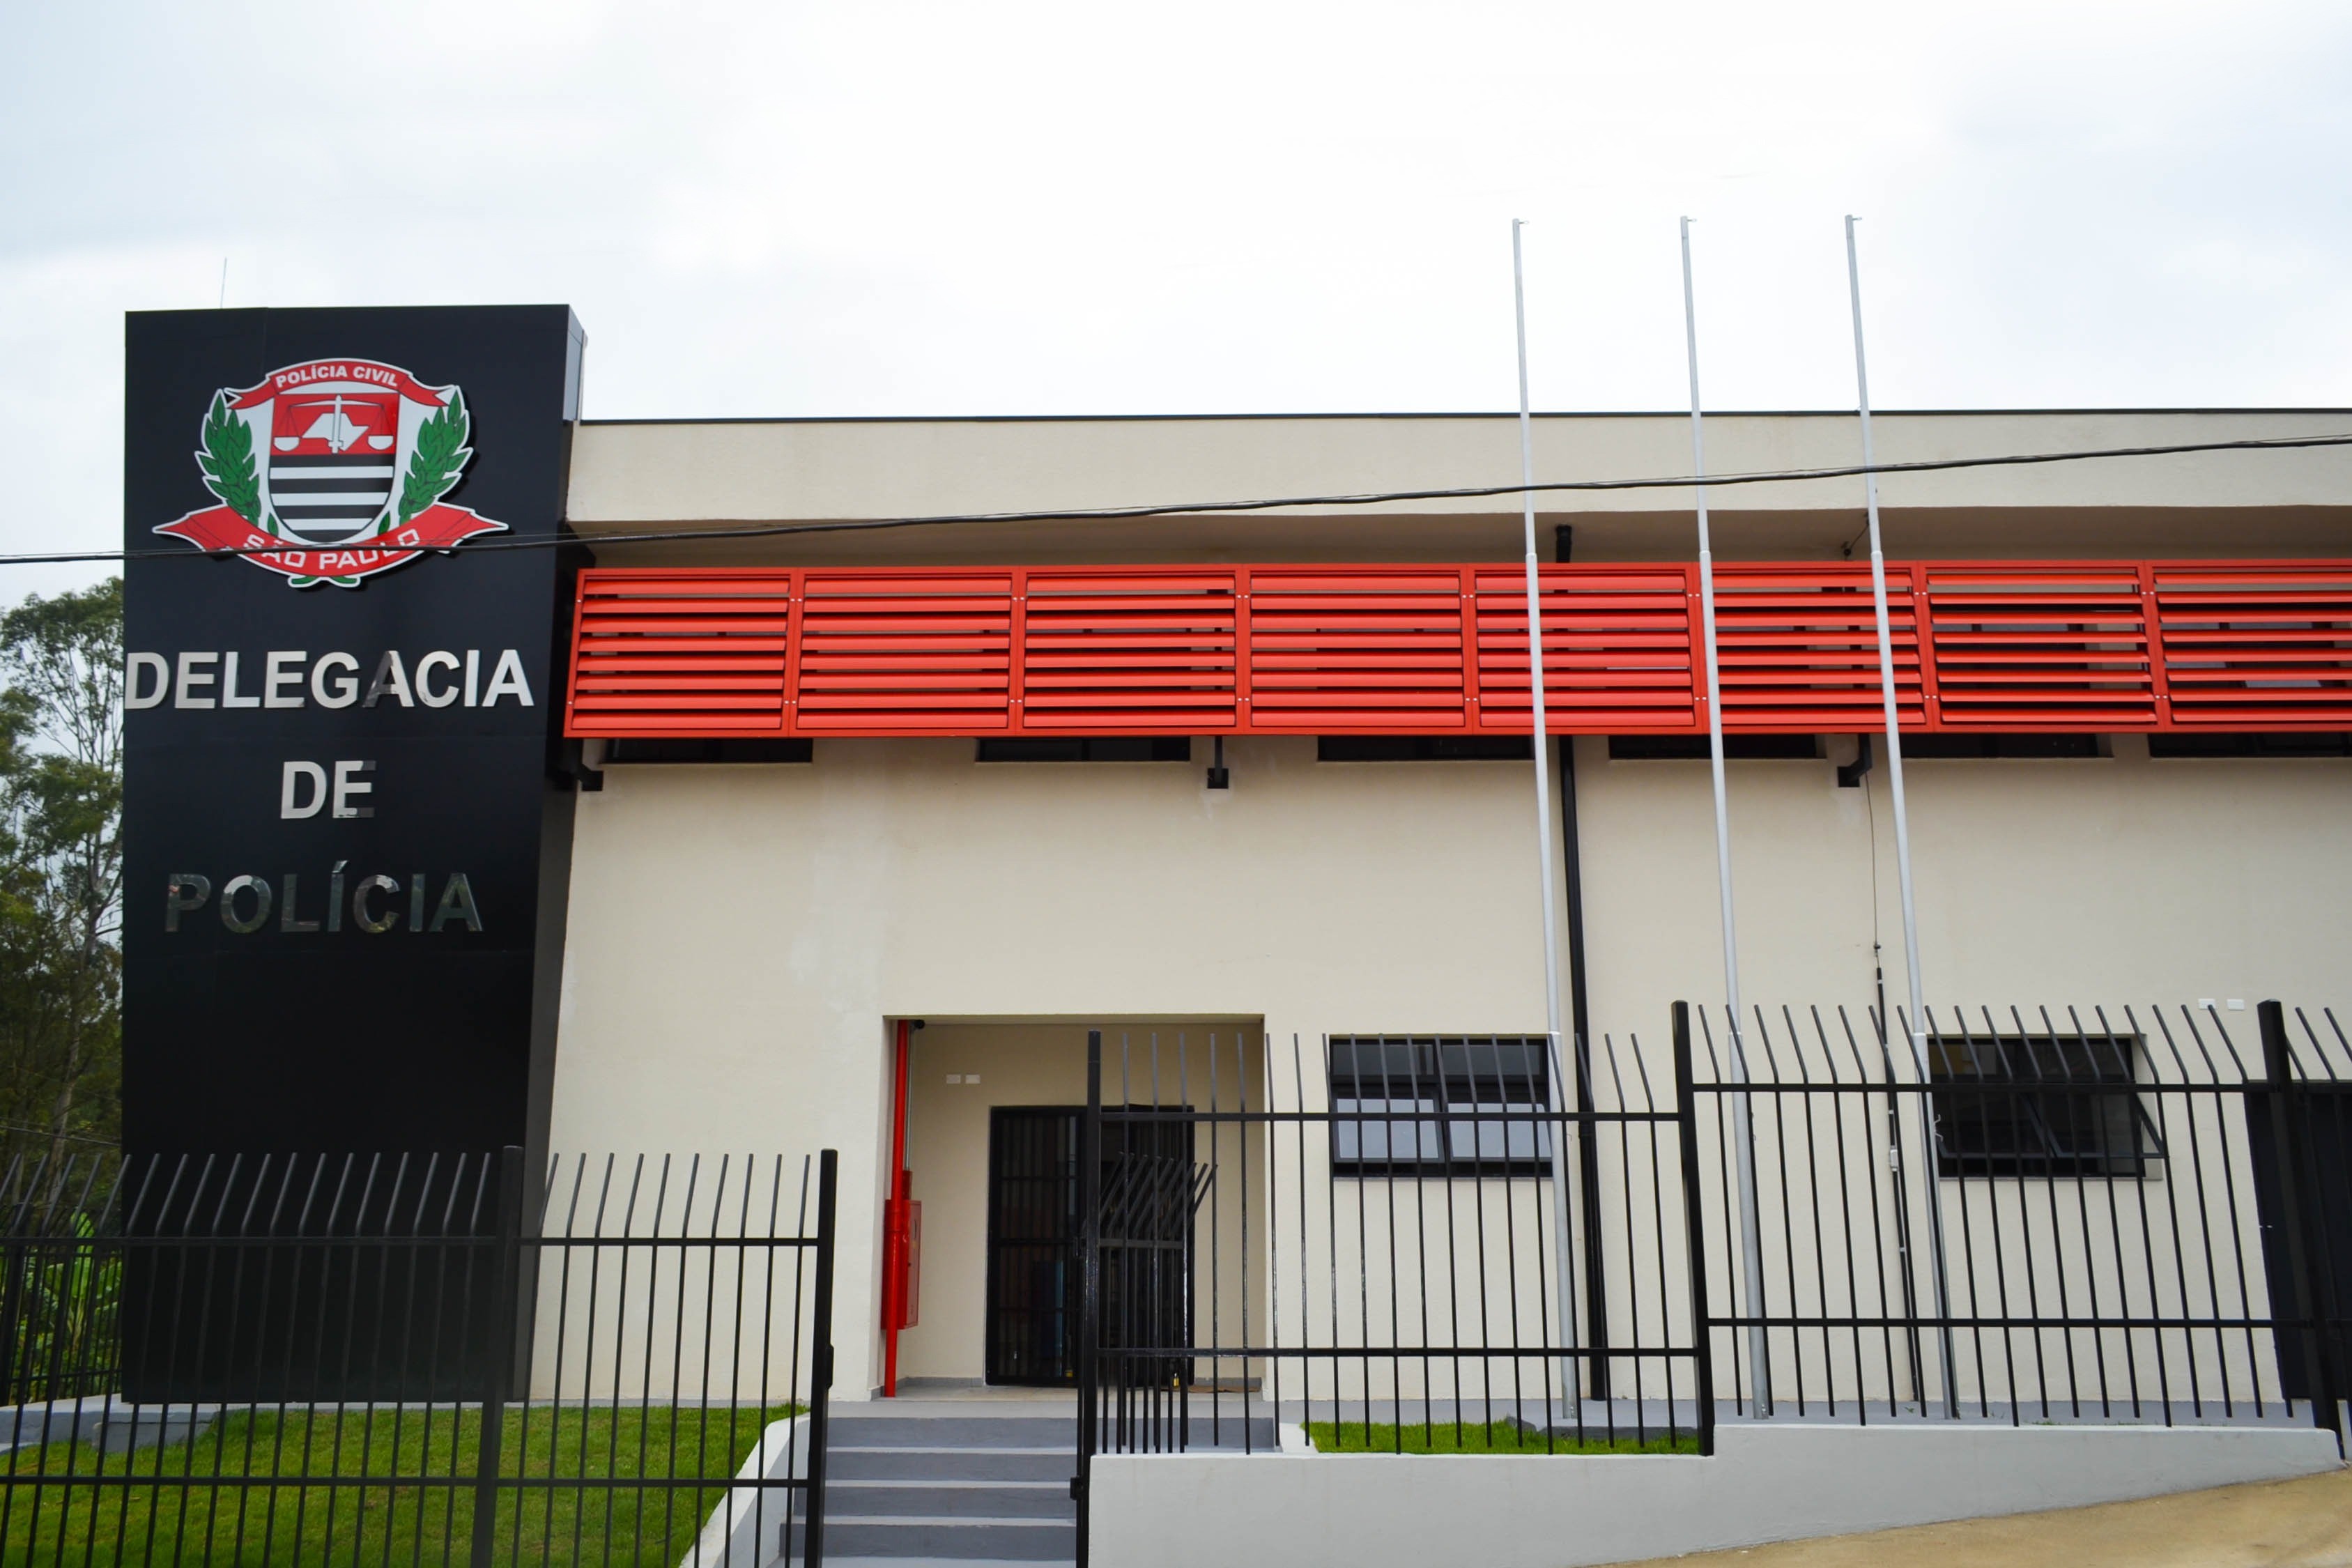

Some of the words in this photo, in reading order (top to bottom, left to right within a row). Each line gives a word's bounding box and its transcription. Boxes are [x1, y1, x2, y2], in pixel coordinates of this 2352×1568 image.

[275, 364, 348, 388] POLÍCIA
[353, 366, 398, 387] CIVIL
[318, 528, 420, 569] PAULO
[124, 650, 535, 709] DELEGACIA
[280, 760, 376, 820] DE
[164, 859, 483, 934] POLÍCIA
